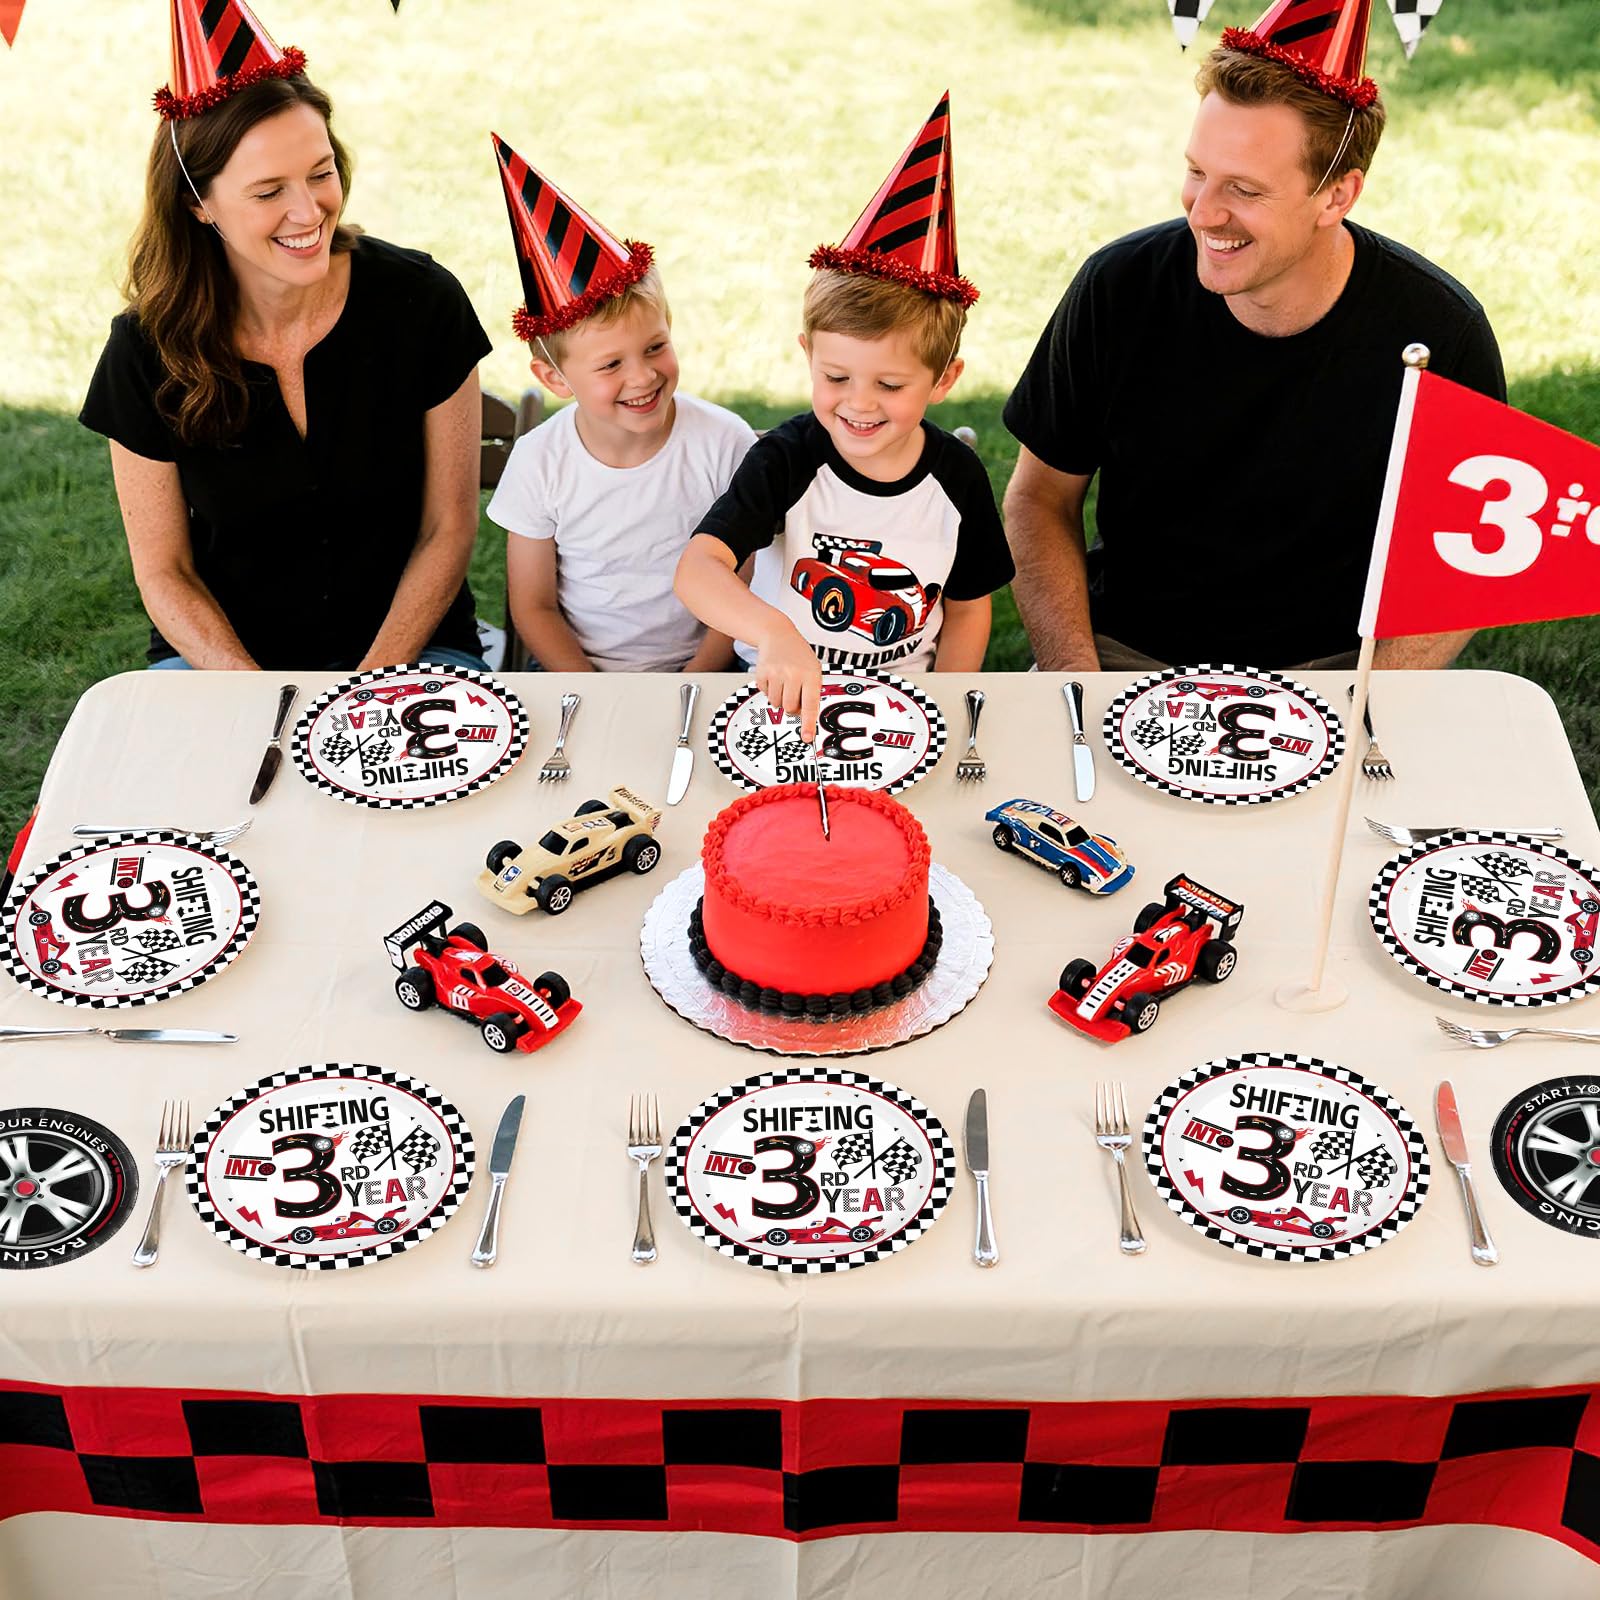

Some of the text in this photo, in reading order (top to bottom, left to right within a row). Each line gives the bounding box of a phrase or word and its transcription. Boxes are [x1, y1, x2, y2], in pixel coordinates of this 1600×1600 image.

[330, 708, 400, 732] YEAR
[750, 707, 801, 725] EAR
[1148, 699, 1217, 721] YEAR
[362, 758, 469, 787] SHIFTING
[777, 763, 883, 783] SHIFTING
[1169, 758, 1278, 782] SHIFTING
[171, 866, 217, 946] SHIFTING
[1414, 867, 1458, 948] SHIFTING
[1527, 870, 1567, 919] YEAR
[76, 932, 115, 987] YEAR
[1229, 1083, 1360, 1130] SHIFTING
[1525, 1086, 1572, 1112] START
[258, 1096, 389, 1134] SHIFTING
[743, 1105, 873, 1133] SHIFTING
[38, 1118, 108, 1153] ENGINES
[343, 1176, 428, 1207] YEAR
[821, 1186, 906, 1213] YEAR
[1293, 1178, 1373, 1217] YEAR
